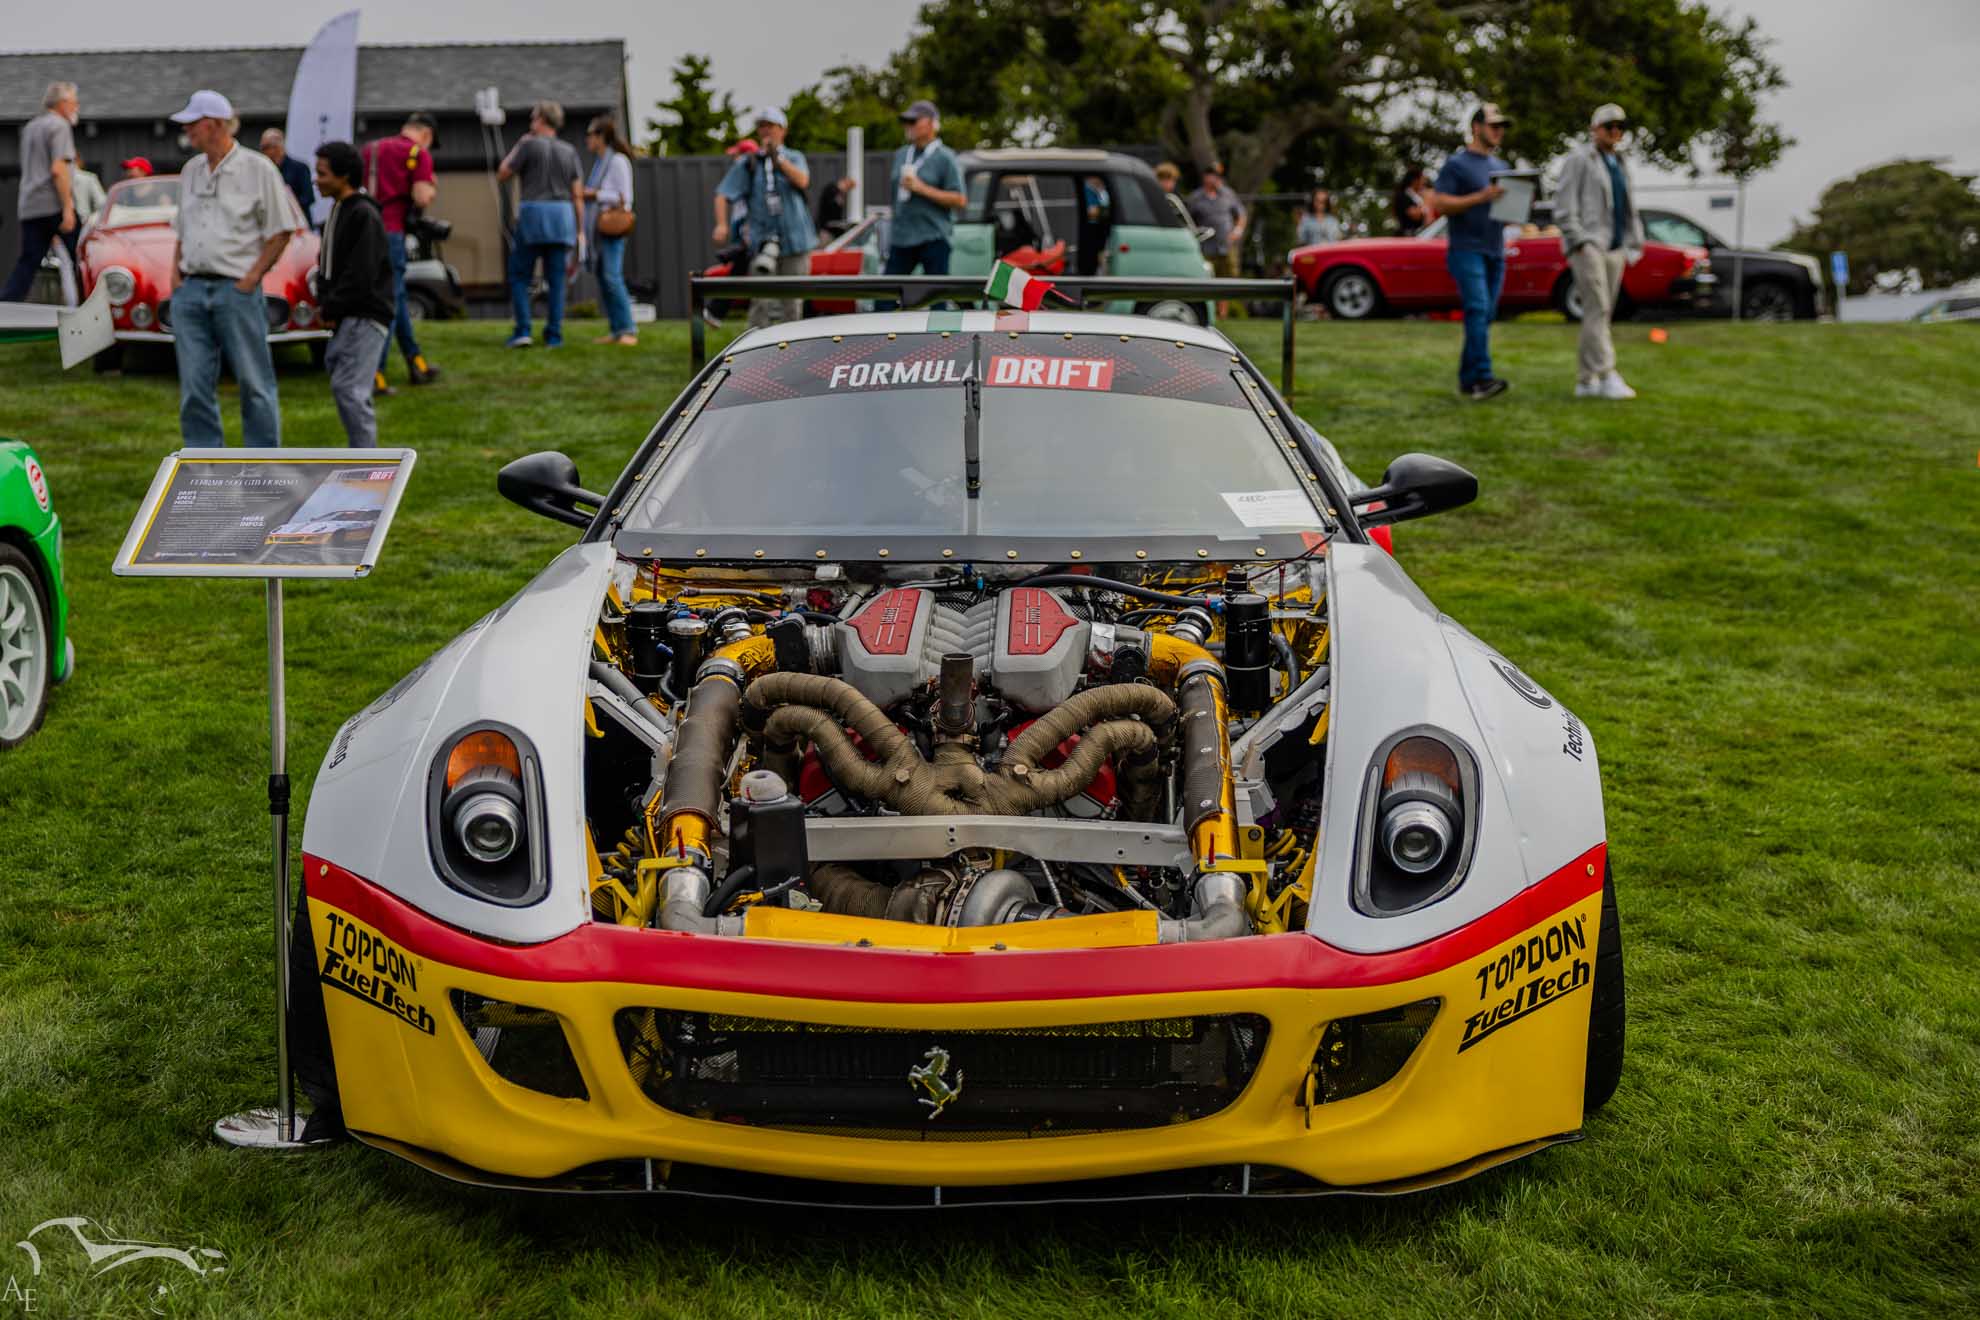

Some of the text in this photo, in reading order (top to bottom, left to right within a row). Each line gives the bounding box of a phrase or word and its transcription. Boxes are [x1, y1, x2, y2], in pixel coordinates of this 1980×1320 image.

[828, 358, 1108, 389] FORMULA DRIFT
[324, 947, 436, 1037] FuelTech
[325, 911, 417, 993] TOPDON
[1475, 915, 1586, 1001] TOPDON
[1460, 957, 1590, 1046] FuelTech
